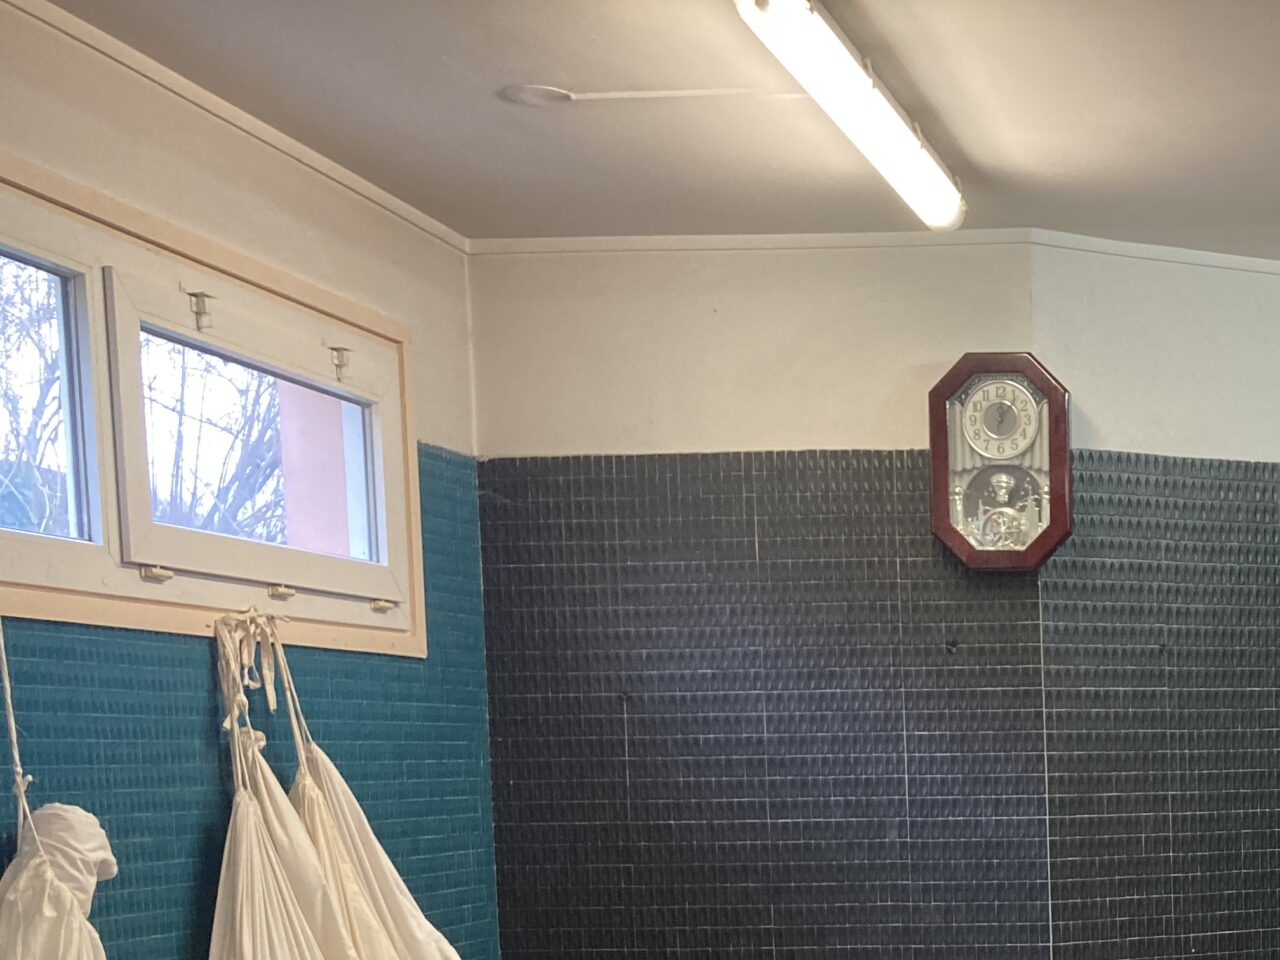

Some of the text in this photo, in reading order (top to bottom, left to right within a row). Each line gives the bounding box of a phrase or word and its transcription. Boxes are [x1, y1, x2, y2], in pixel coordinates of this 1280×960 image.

[982, 389, 990, 401] 11
[995, 386, 1006, 398] 12
[972, 401, 982, 412] 10
[1020, 400, 1028, 412] 2
[969, 414, 976, 426] 9
[1024, 414, 1031, 426] 3
[973, 429, 981, 440] 8
[1019, 428, 1026, 439] 4
[983, 439, 990, 451] 7
[997, 443, 1005, 454] 6
[1011, 439, 1018, 450] 5
